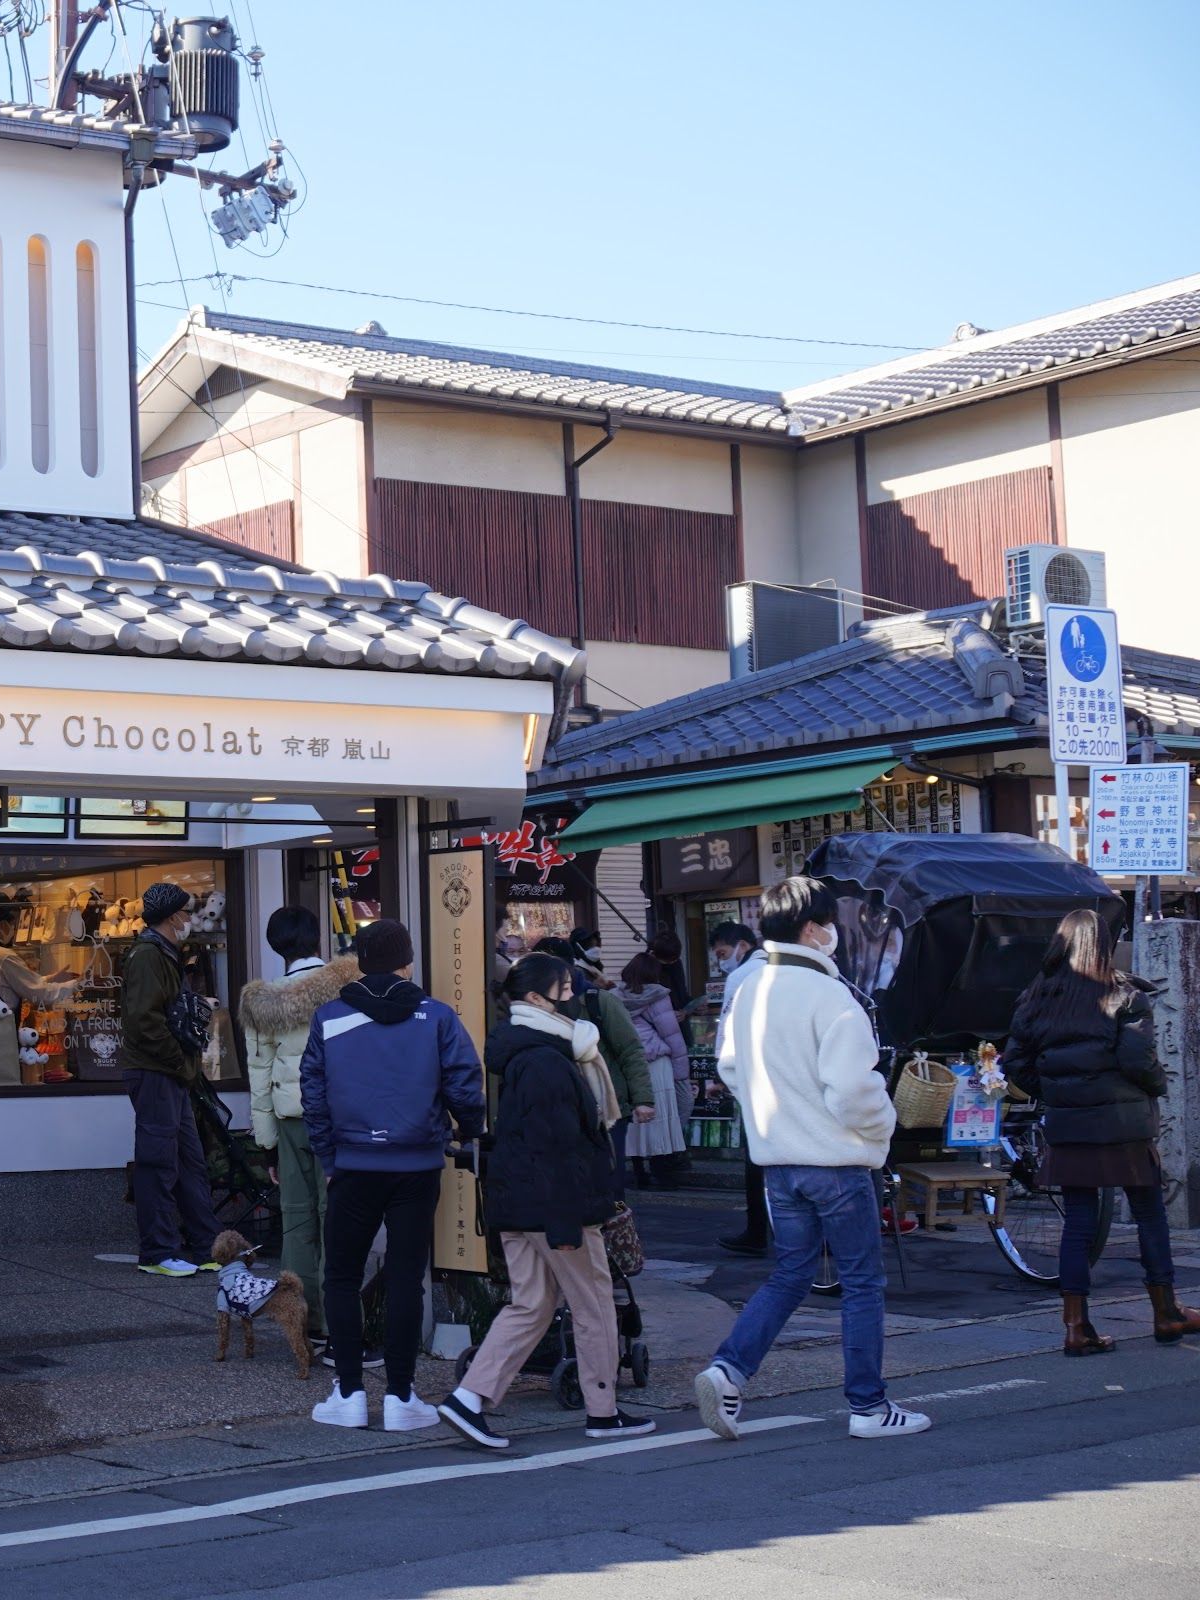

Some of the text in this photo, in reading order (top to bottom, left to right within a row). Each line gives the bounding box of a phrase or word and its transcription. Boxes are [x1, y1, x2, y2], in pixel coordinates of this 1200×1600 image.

[1056, 699, 1116, 712] 歩行者用道路
[62, 715, 263, 757] Chocolat
[281, 735, 390, 761] 京都 嵐山
[1058, 739, 1120, 756] この先200m
[1121, 770, 1177, 783] 竹林の小径
[1120, 805, 1177, 817] 野宮神社
[1120, 818, 1177, 827] Nonomiya Shrine
[1119, 837, 1177, 848] 常寂光寺
[680, 838, 732, 873] 三忠
[1152, 849, 1177, 858] Temple
[440, 862, 473, 880] SNOOPY
[74, 1017, 83, 1032] A
[88, 1016, 123, 1031] FRIEN
[63, 1034, 79, 1049] ON
